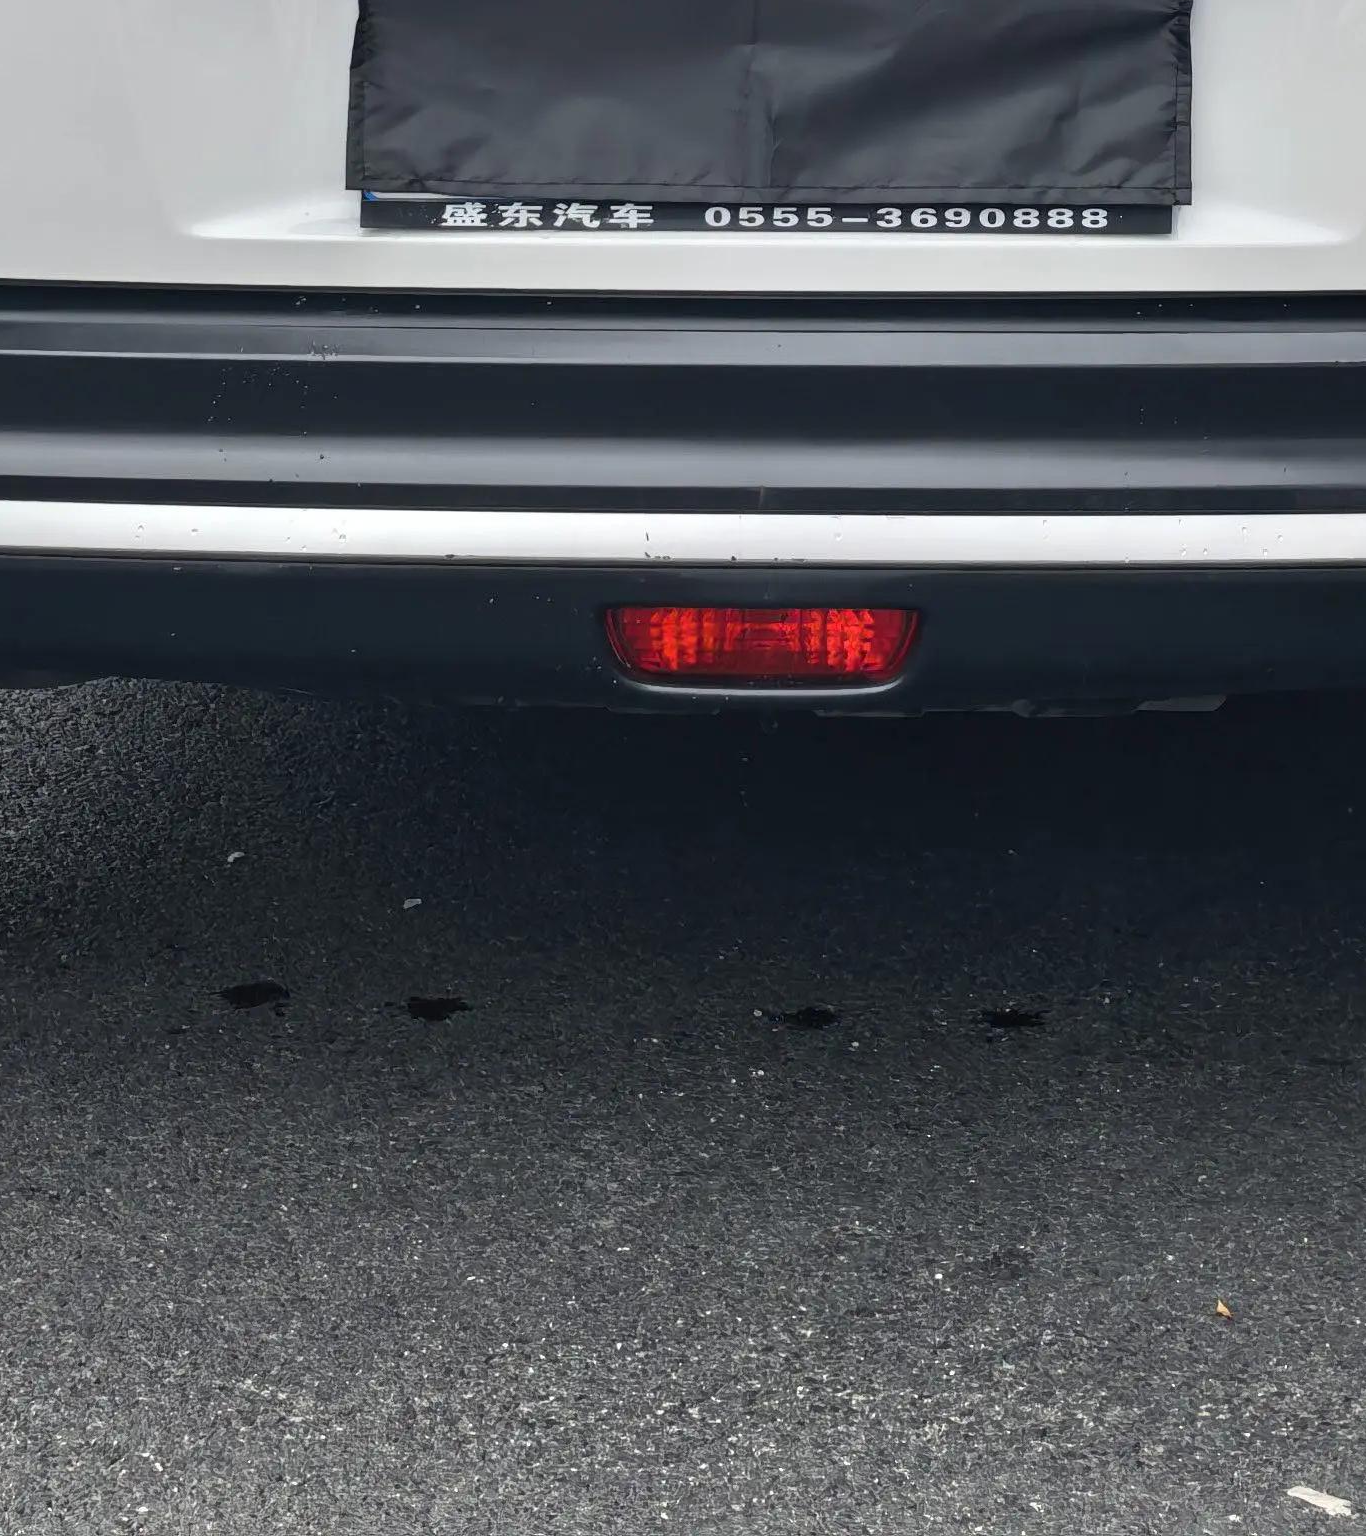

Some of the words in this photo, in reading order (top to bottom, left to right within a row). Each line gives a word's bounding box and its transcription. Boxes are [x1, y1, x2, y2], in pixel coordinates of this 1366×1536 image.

[440, 202, 654, 228] 盛东汽车
[704, 206, 1109, 229] 0555-3690888
